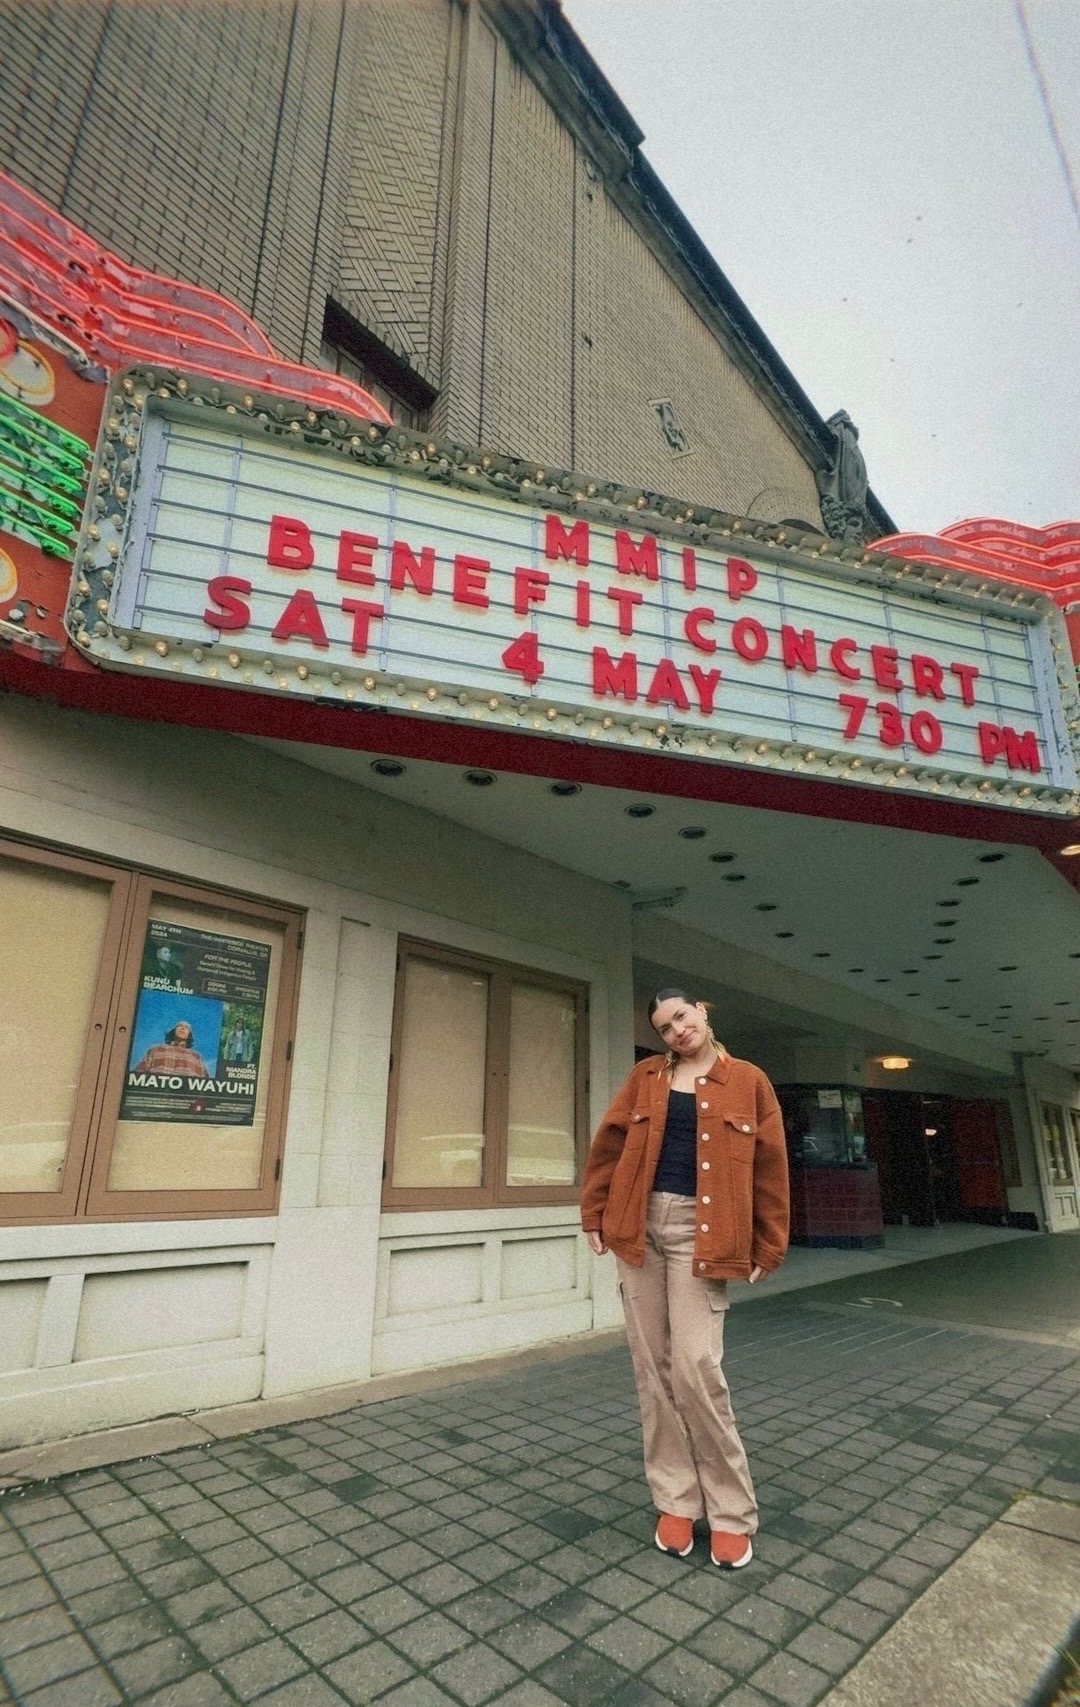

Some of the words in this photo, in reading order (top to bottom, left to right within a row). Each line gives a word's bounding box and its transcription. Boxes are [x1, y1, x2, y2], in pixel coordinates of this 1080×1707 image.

[545, 514, 758, 600] MMIP
[267, 514, 642, 636] BENEFIT
[684, 606, 979, 705] CONCERT
[203, 576, 384, 655] SAT
[501, 631, 545, 685] 4
[592, 646, 722, 714] MAY
[838, 693, 943, 755] 730
[978, 721, 1041, 773] PM
[231, 960, 252, 968] PEOPLE
[143, 982, 193, 995] BEARCHUM
[226, 1067, 256, 1075] NIANDRA
[228, 1072, 256, 1080] BLONDE
[128, 1074, 183, 1090] MATO
[187, 1077, 255, 1095] WAYUHI
